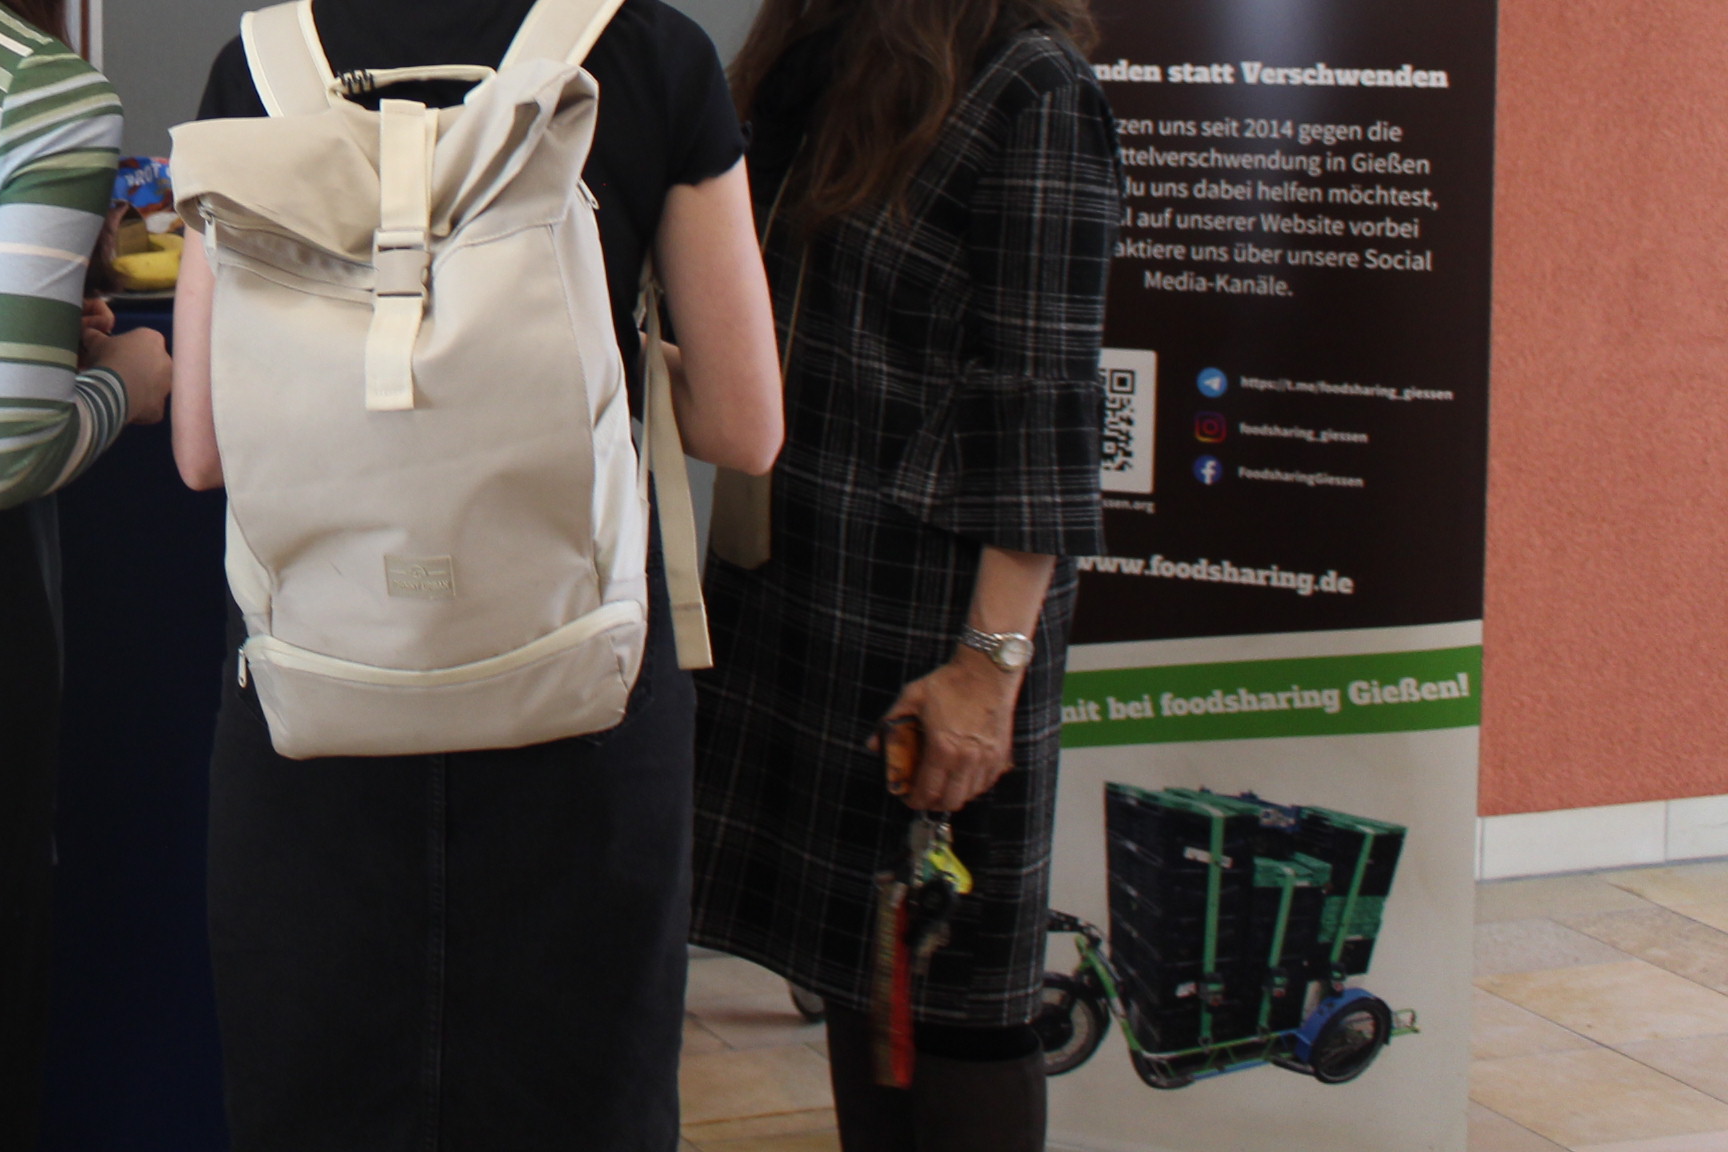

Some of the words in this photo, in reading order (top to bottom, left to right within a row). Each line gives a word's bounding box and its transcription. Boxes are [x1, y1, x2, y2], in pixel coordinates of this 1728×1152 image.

[1168, 61, 1234, 84] statt
[1241, 61, 1449, 88] Verschwenden
[1159, 120, 1197, 136] uns
[1200, 119, 1238, 138] seit
[1243, 119, 1293, 139] 2014
[1298, 122, 1361, 145] gegen
[1368, 121, 1403, 143] die
[1119, 147, 1322, 177] ttelverschwendung
[1327, 150, 1347, 172] in
[1351, 152, 1430, 175] Gießen
[1150, 181, 1189, 199] uns
[1193, 179, 1252, 201] dabei
[1257, 181, 1323, 203] helfen
[1328, 182, 1439, 211] möchtest,
[1137, 208, 1172, 229] auf
[1176, 213, 1255, 232] unserer
[1260, 213, 1345, 236] Website
[1349, 216, 1420, 239] vorbei
[1115, 239, 1186, 260] aktiere
[1190, 245, 1228, 263] uns
[1233, 243, 1281, 265] über
[1287, 249, 1359, 269] unsere
[1364, 249, 1433, 272] Social
[1144, 270, 1293, 297] Media-Kanäle.
[1239, 422, 1369, 445] foodsharing_giessen
[1076, 554, 1354, 596] www.foodsharing.de
[1107, 694, 1154, 720] bei
[1161, 684, 1341, 717] foodsharing
[1348, 673, 1469, 707] Gießen!
